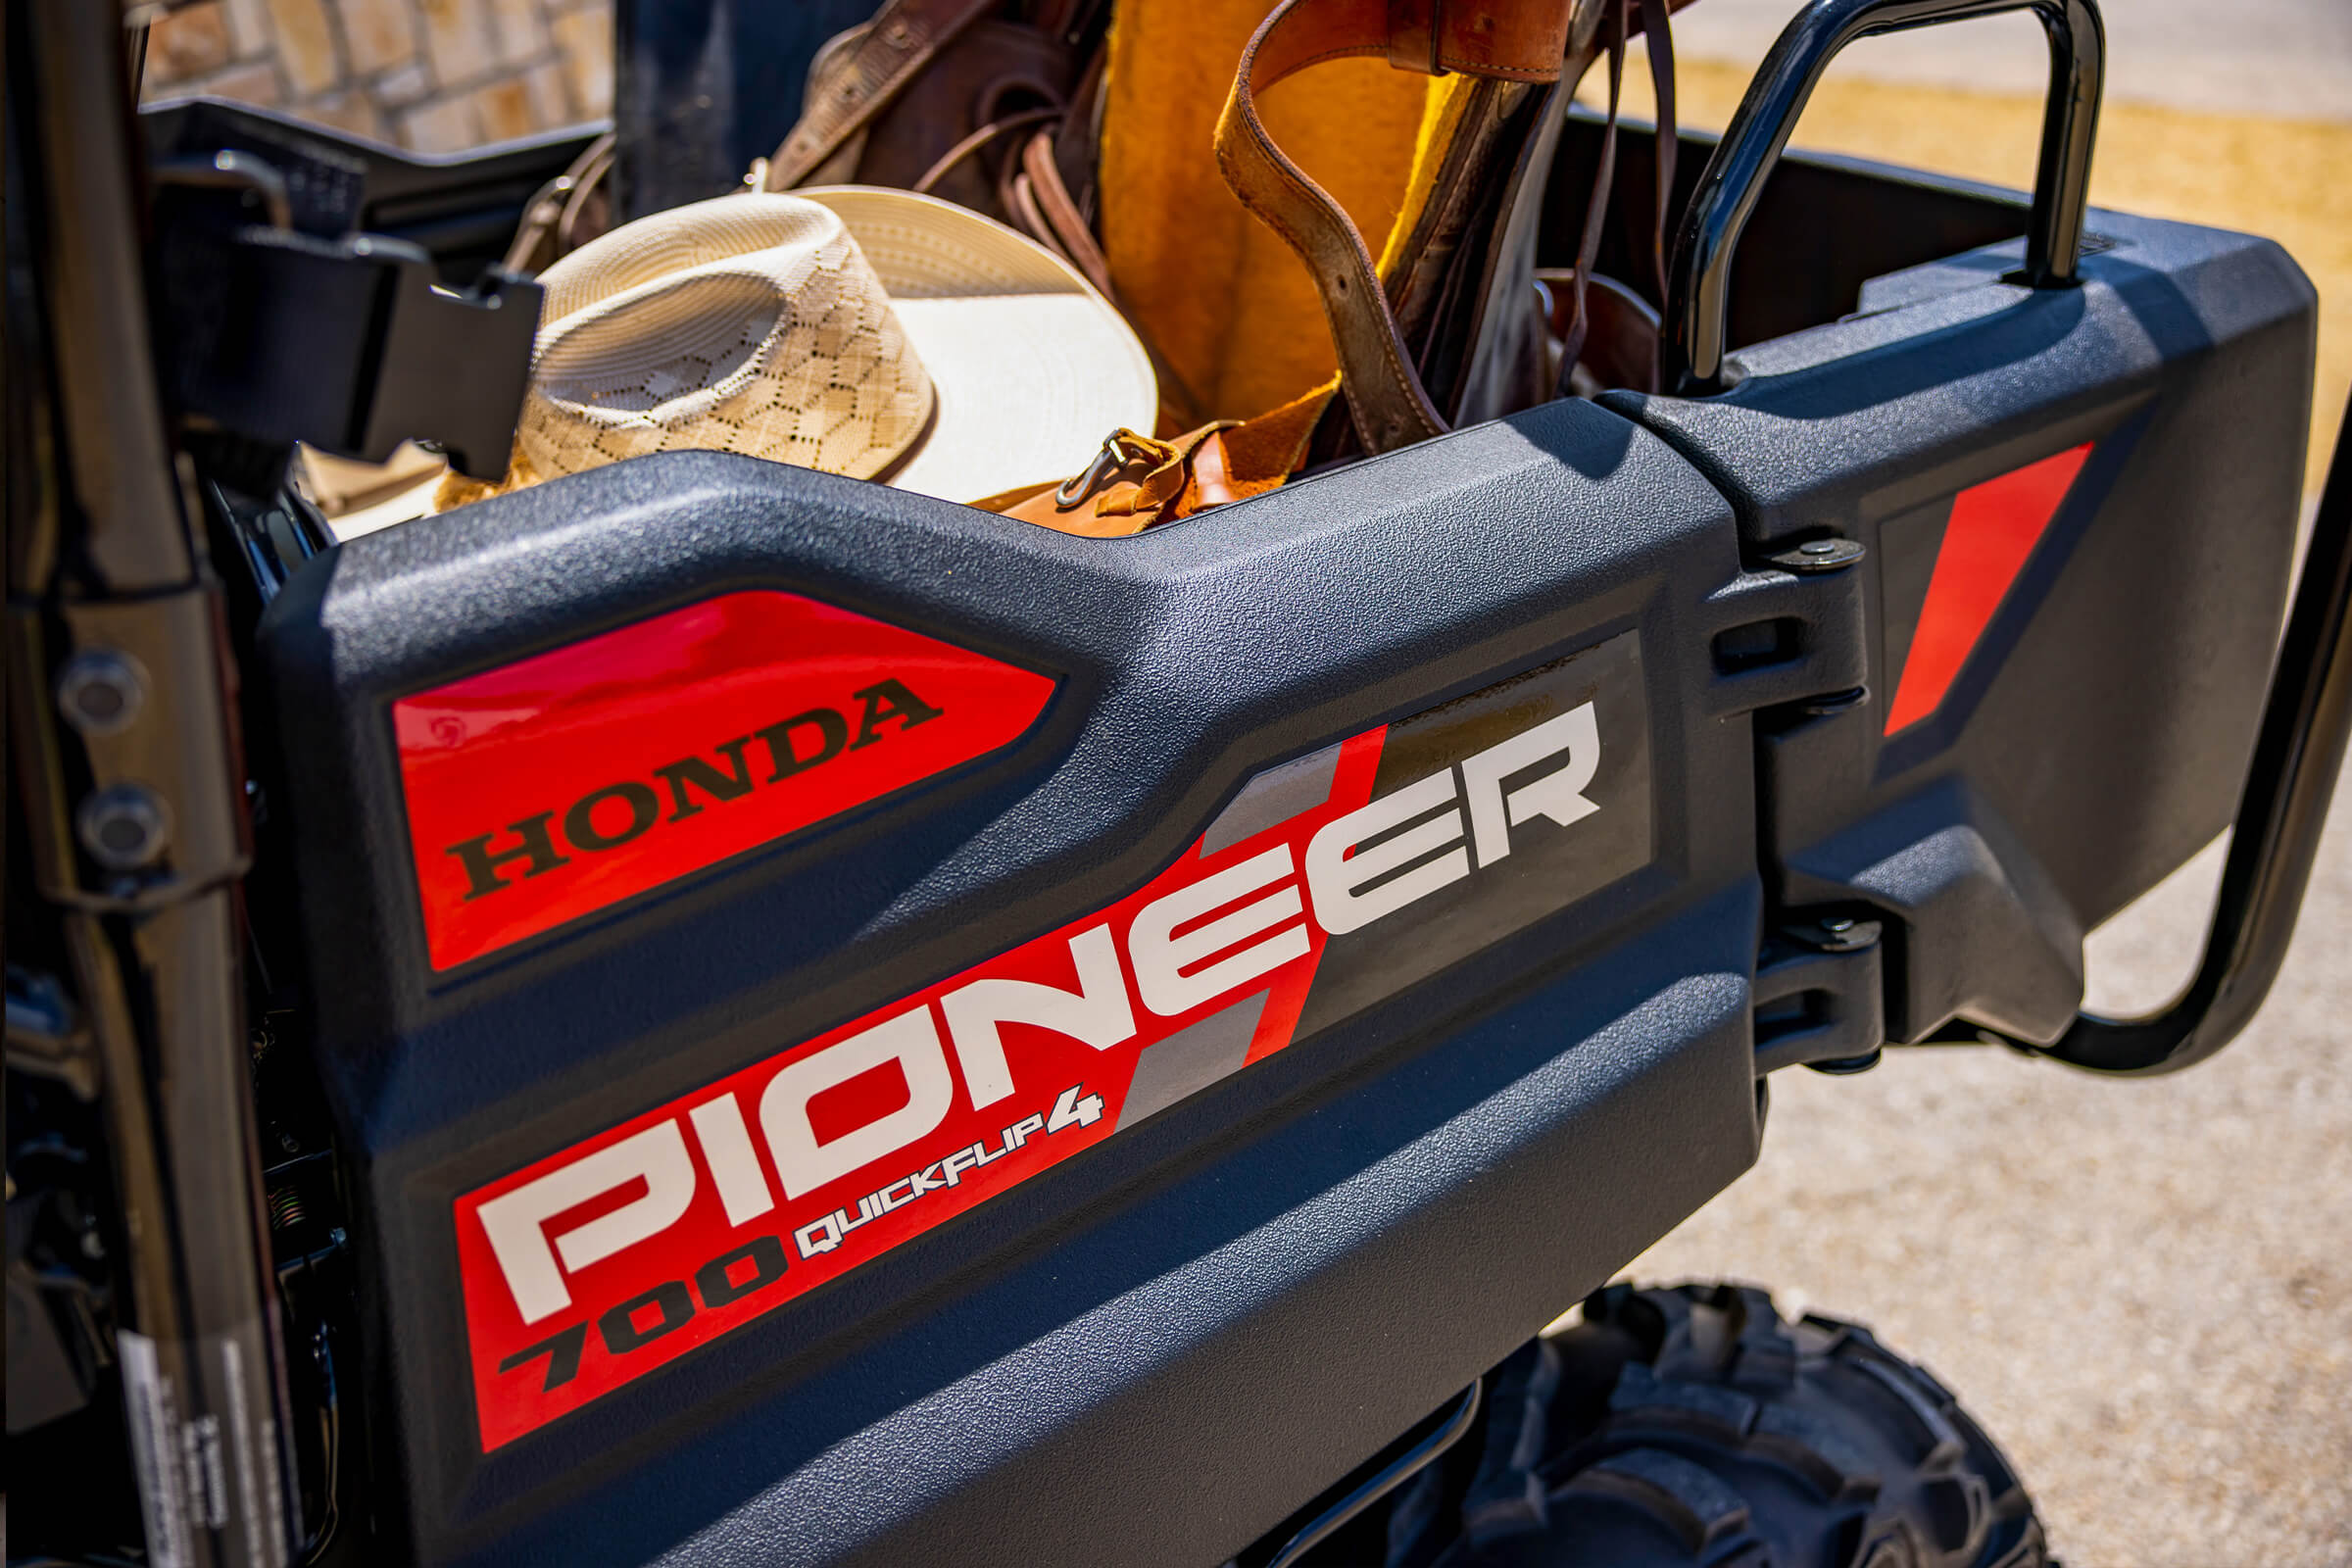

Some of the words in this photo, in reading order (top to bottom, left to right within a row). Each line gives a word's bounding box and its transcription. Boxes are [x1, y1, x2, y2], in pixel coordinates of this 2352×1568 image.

[445, 678, 944, 901] HONDA
[477, 701, 1600, 1325] PIONEER
[498, 1236, 788, 1392] 700
